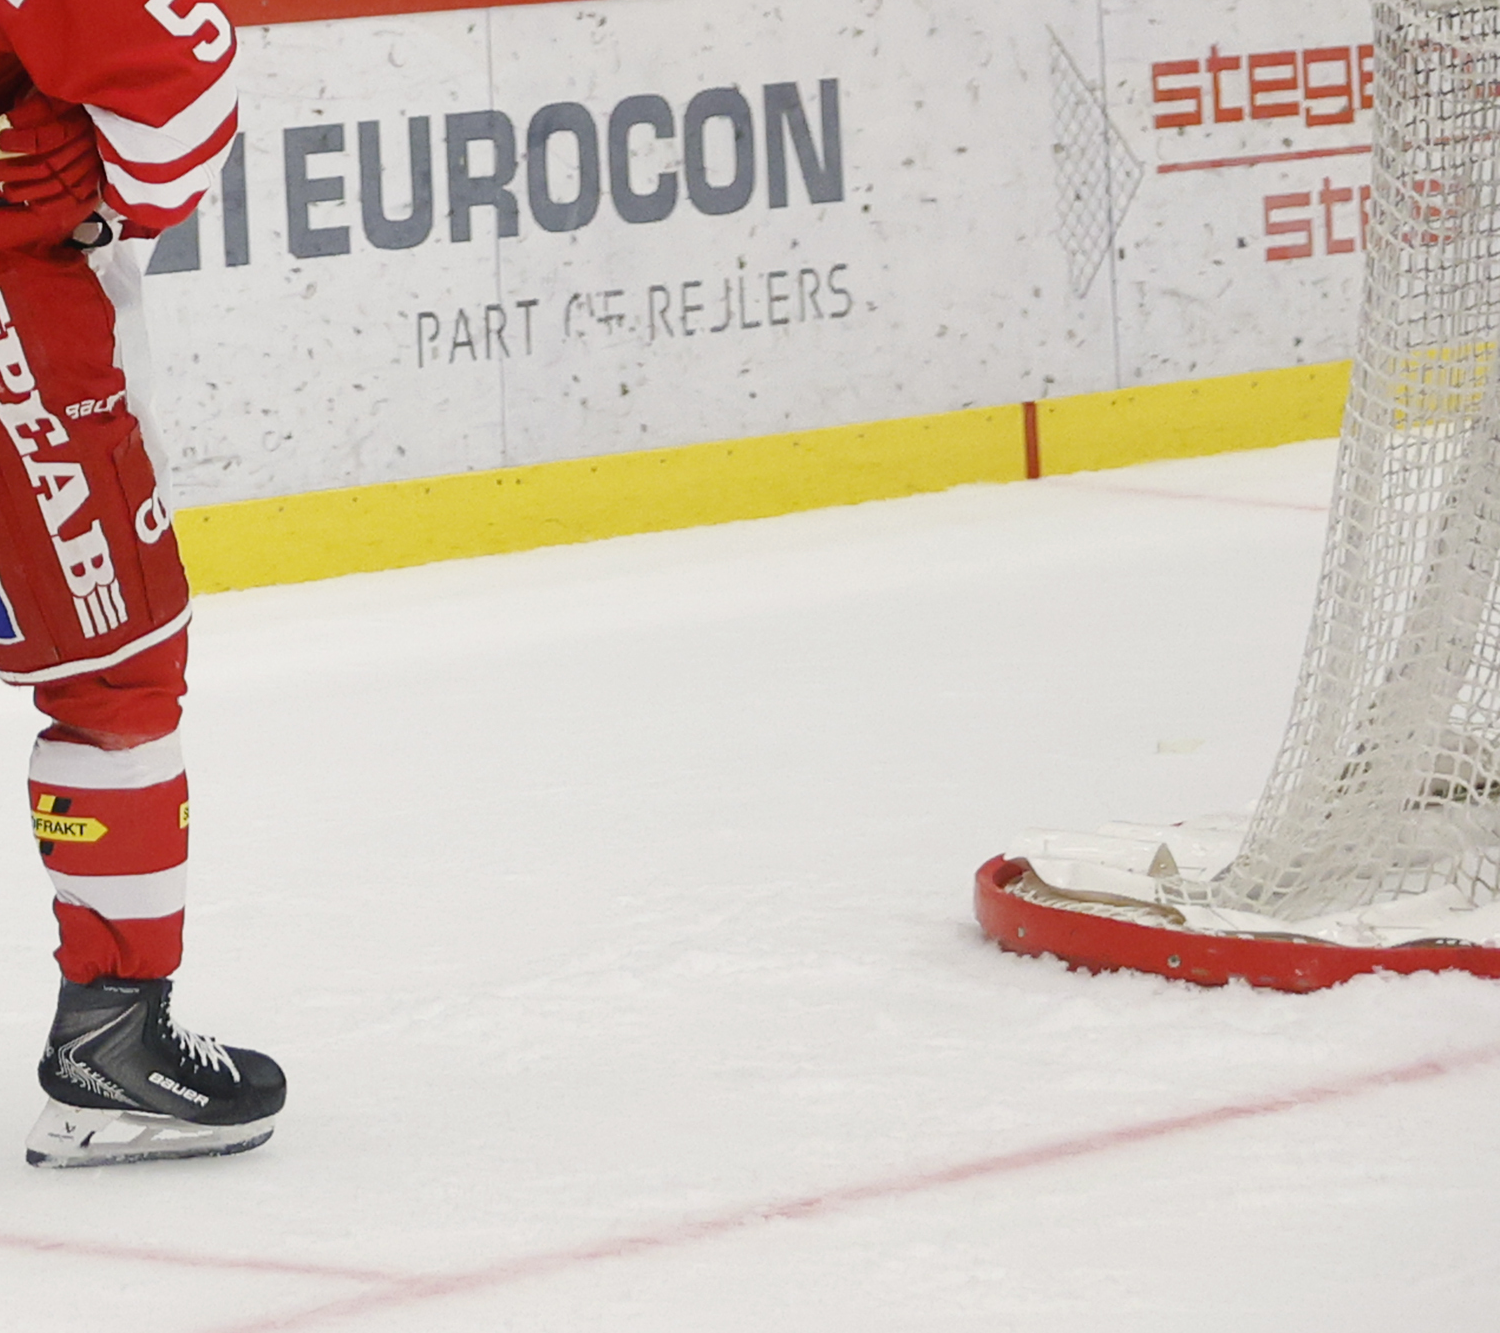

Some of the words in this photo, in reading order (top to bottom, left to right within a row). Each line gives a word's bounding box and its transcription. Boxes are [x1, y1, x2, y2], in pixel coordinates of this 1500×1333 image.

[284, 79, 847, 259] EUROCON
[414, 297, 542, 369] PART
[645, 261, 855, 336] REJLERS
[32, 817, 89, 838] FRAKT
[148, 1070, 210, 1108] BAUER
